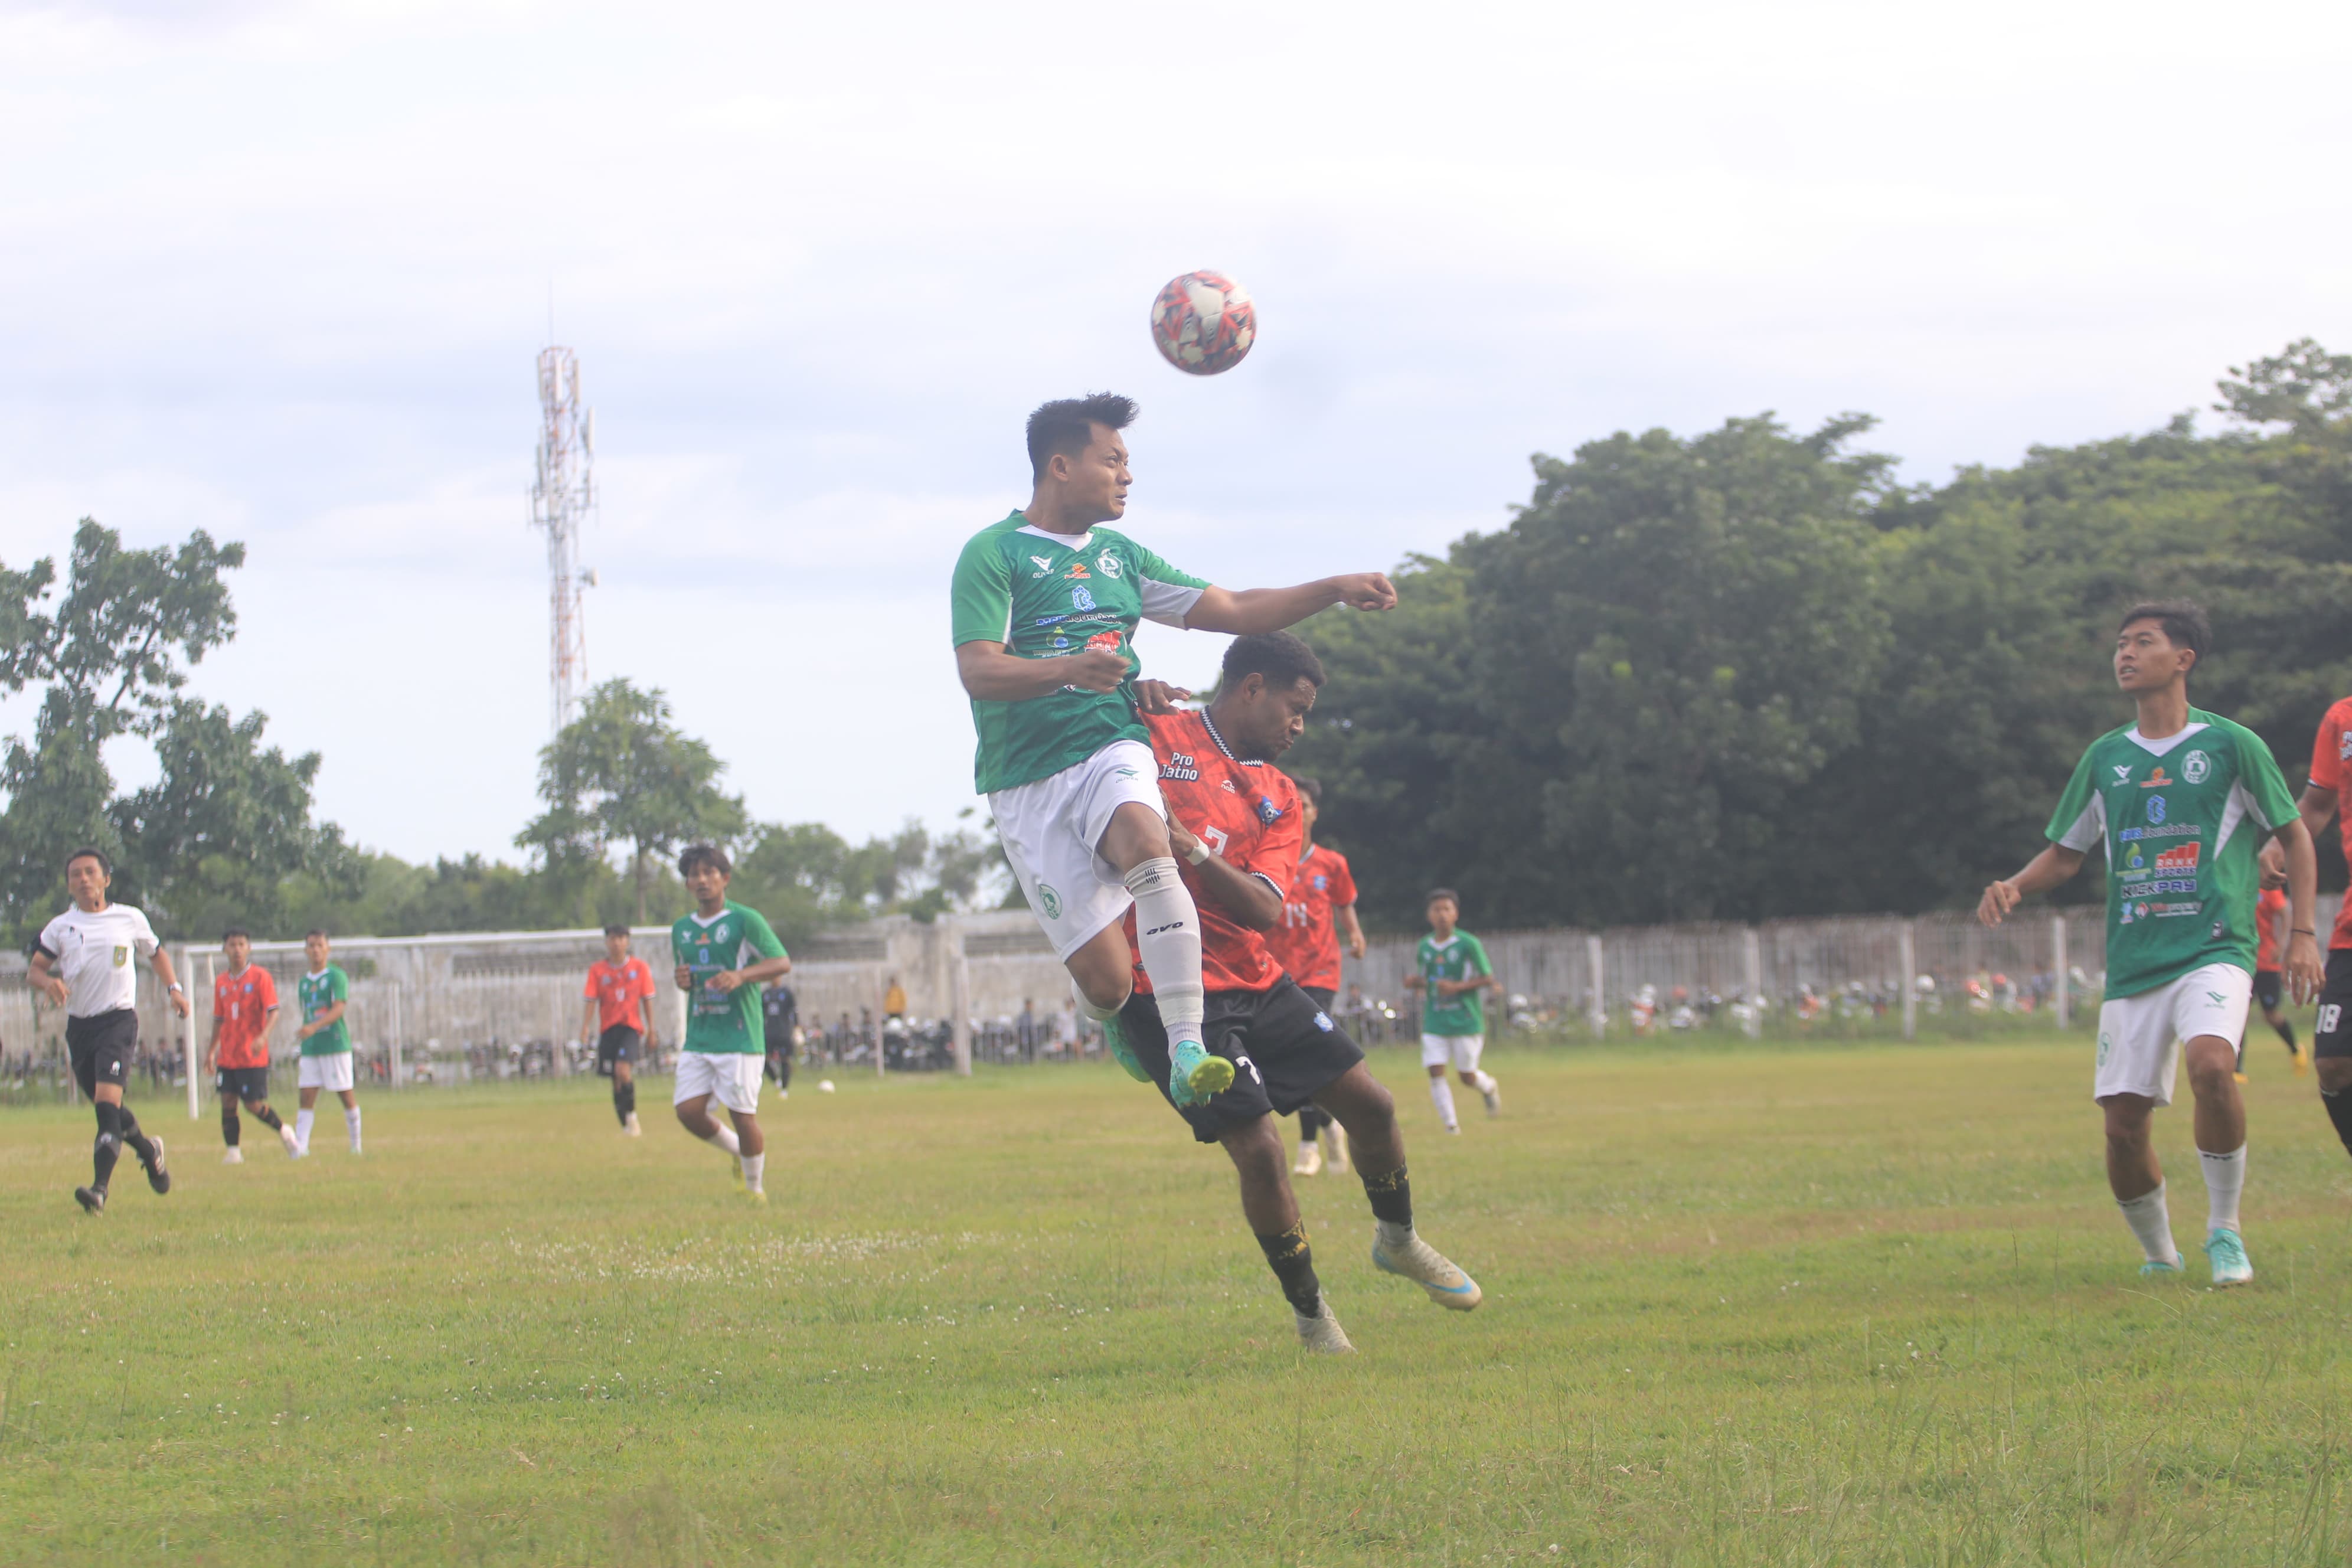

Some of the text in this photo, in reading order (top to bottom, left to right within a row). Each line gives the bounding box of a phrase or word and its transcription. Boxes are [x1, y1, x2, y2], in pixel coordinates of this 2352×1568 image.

[1158, 764, 1198, 781] Jatno
[1170, 751, 1194, 766] Pro
[1204, 825, 1229, 855] 7
[1285, 901, 1308, 929] 14
[2314, 1004, 2343, 1034] 18
[1235, 1056, 1261, 1085] 7
